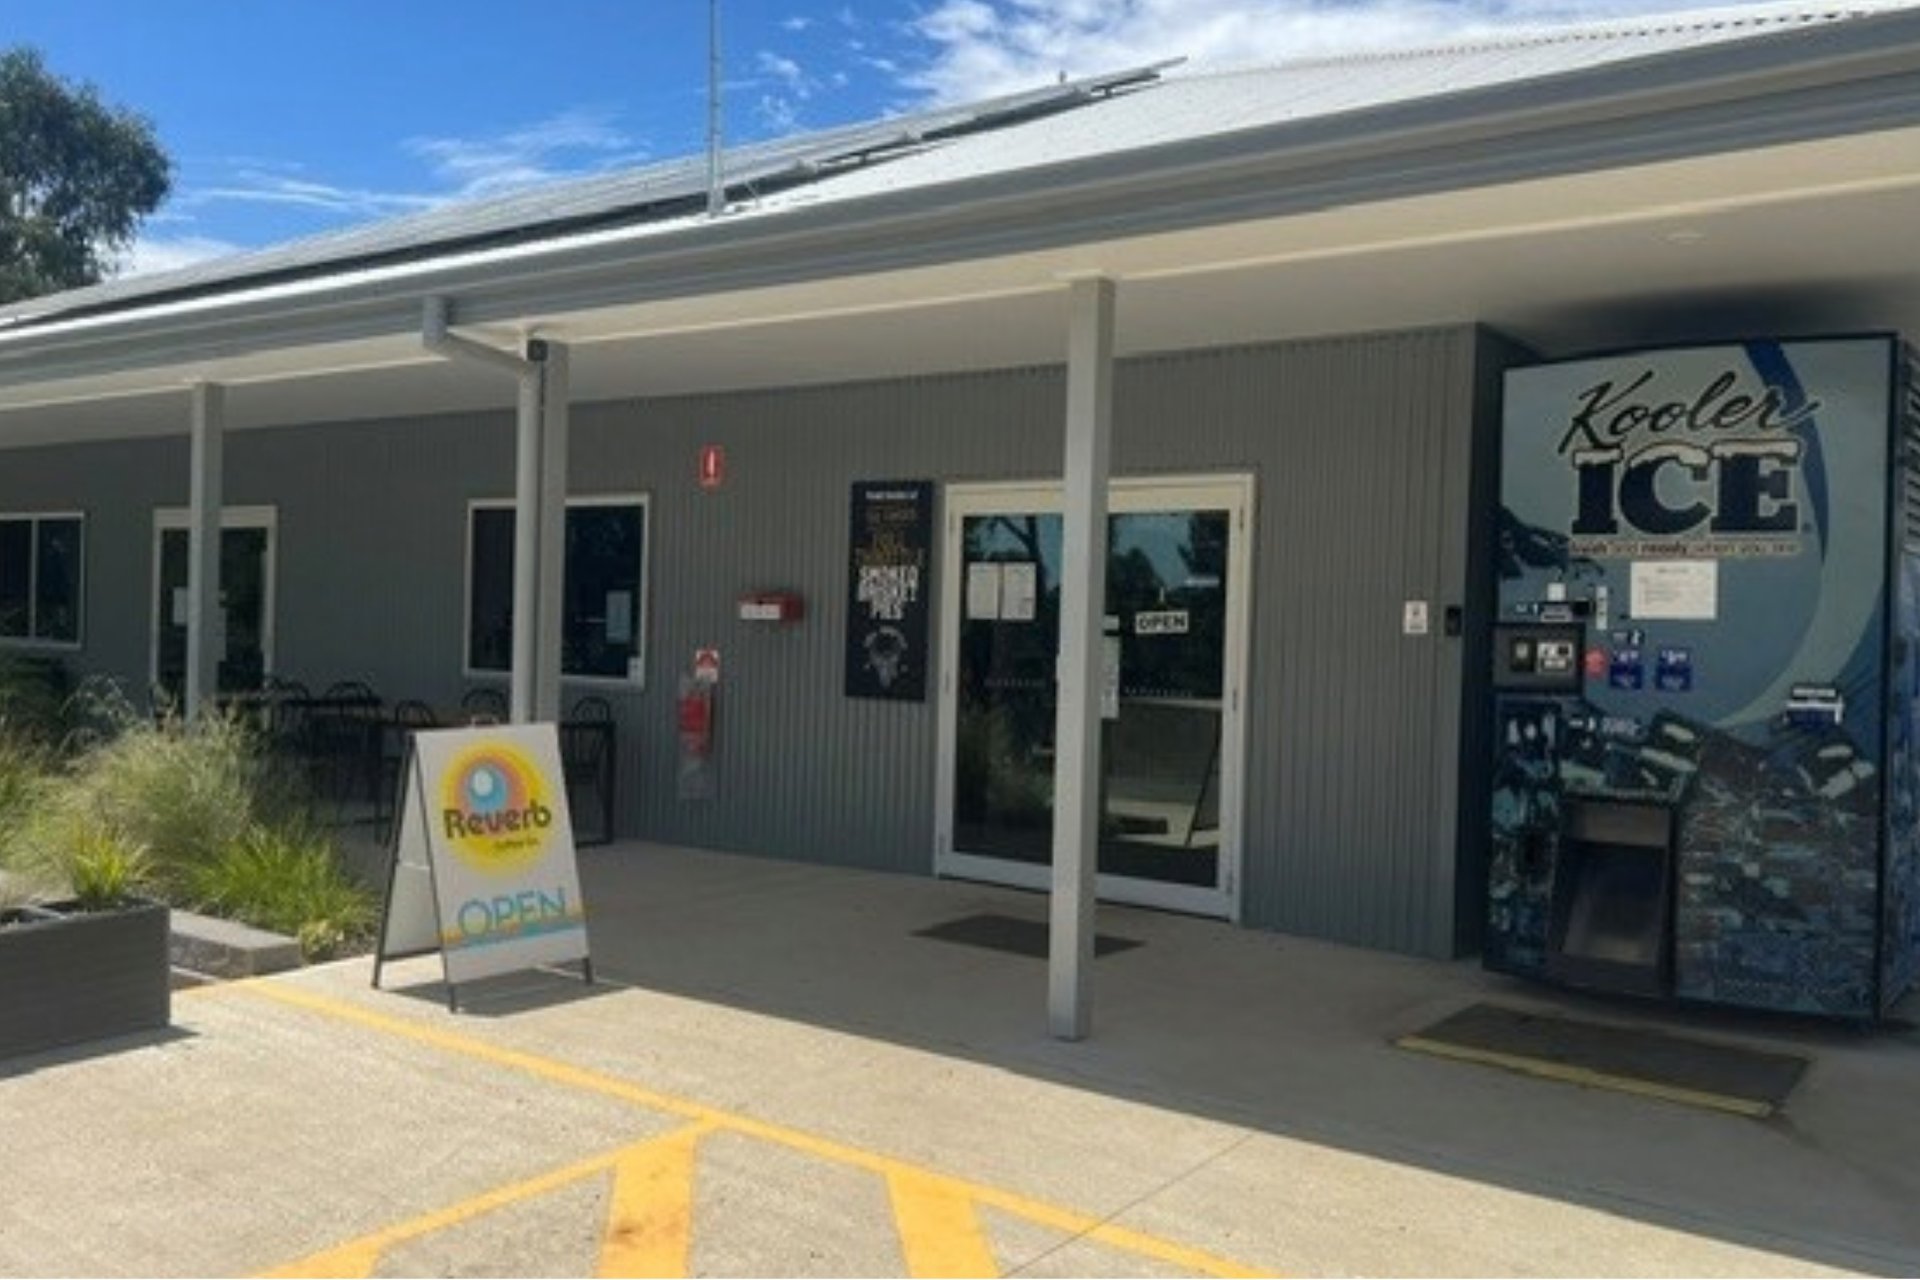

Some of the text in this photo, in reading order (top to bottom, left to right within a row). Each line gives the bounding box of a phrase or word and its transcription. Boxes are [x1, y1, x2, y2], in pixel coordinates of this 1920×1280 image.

[1558, 370, 1820, 454] Kooler
[1571, 438, 1800, 535] ICE
[1137, 613, 1186, 631] OPEN
[442, 798, 552, 839] Reverb
[457, 886, 567, 937] OPEN
